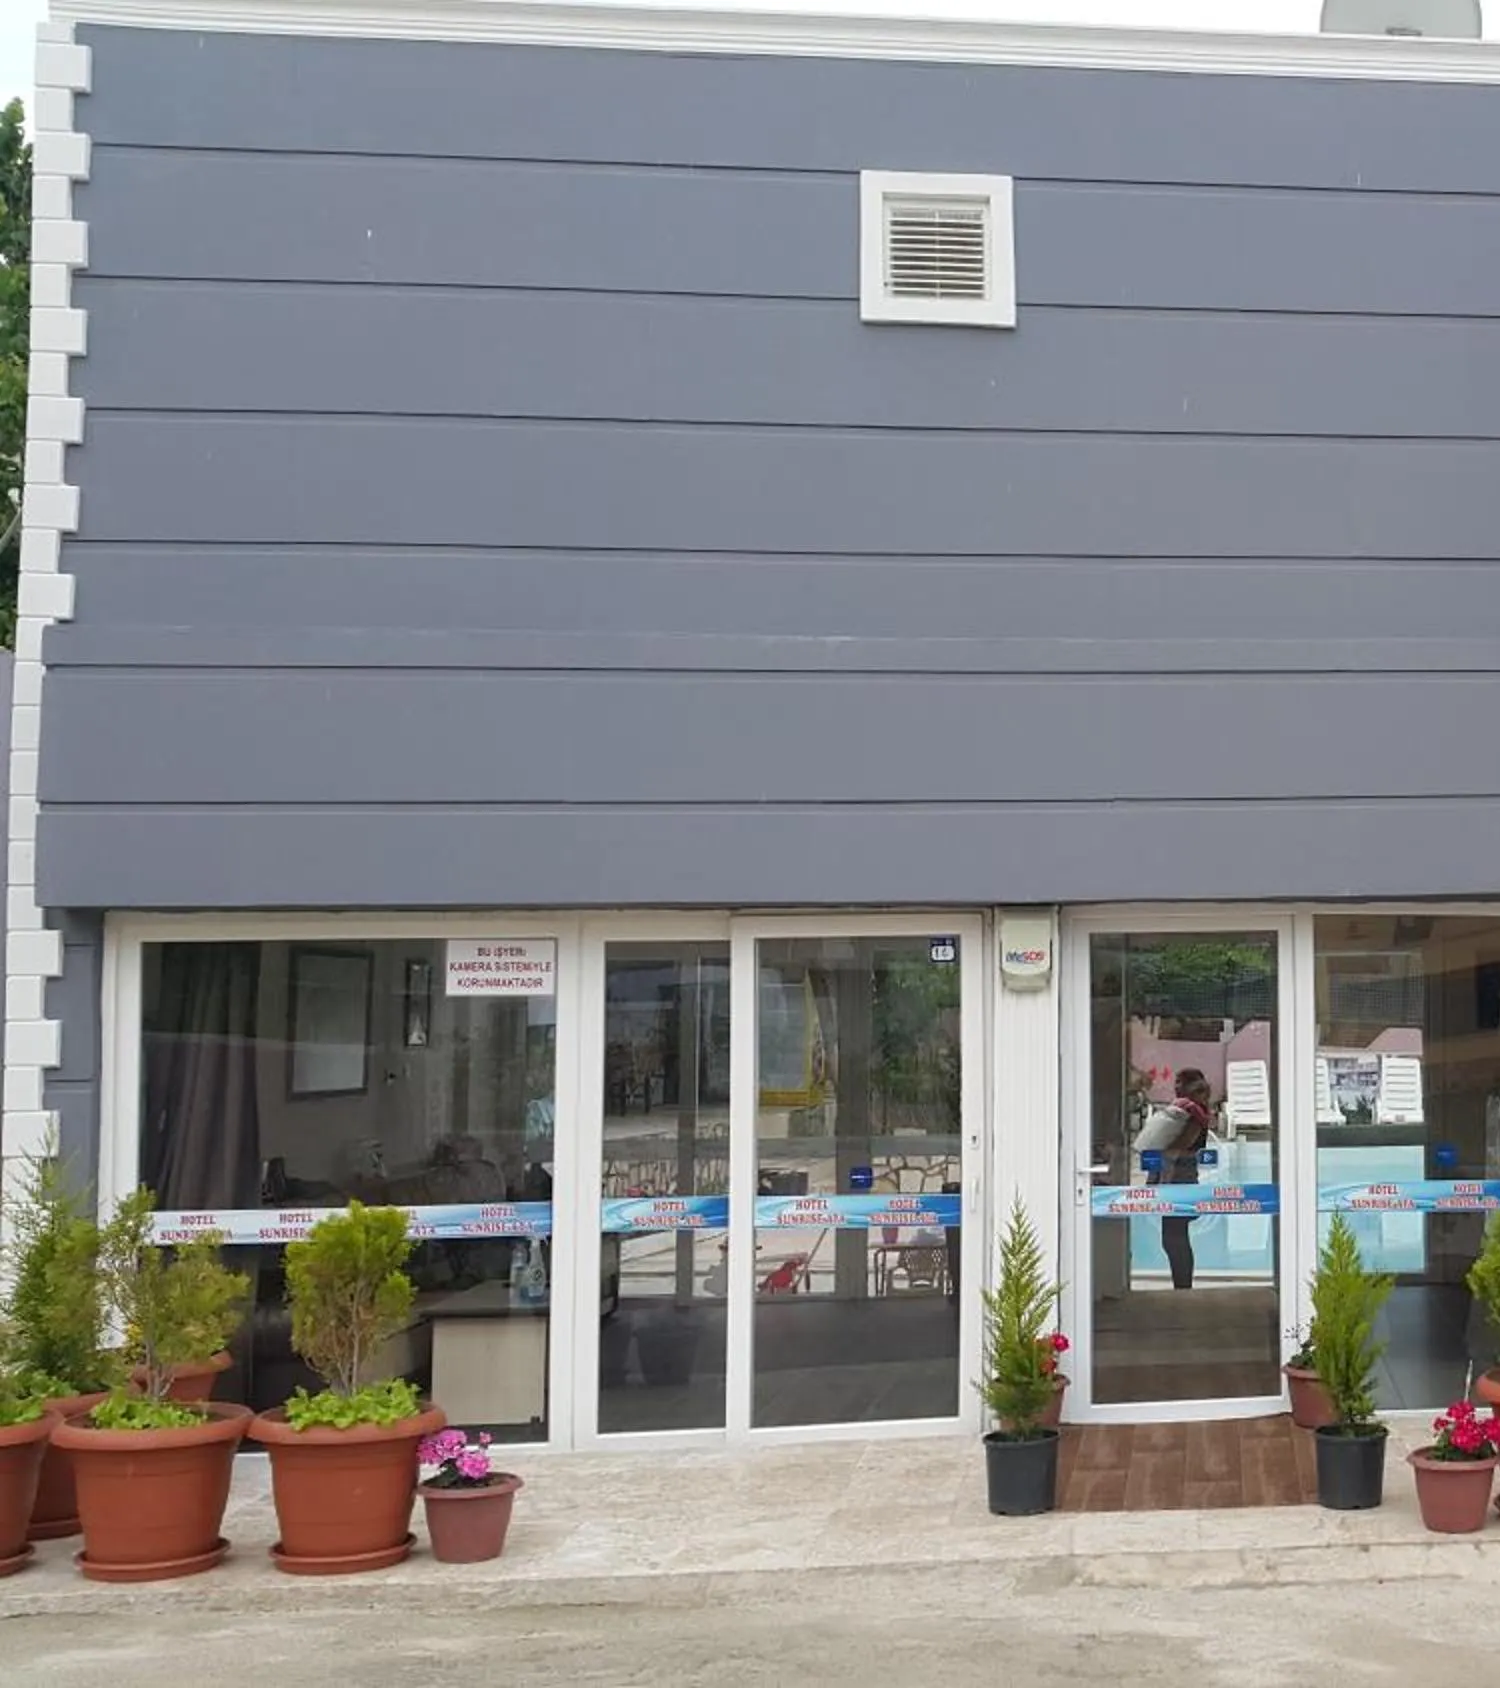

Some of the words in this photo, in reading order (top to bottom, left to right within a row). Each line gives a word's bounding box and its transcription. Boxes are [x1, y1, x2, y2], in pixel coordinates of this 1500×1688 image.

[449, 962, 492, 972] KAMERA
[457, 978, 543, 988] KORUNMAKTADIR
[654, 1201, 687, 1212] HOTEL
[795, 1199, 828, 1210] HOTEL
[279, 1212, 314, 1223] HOTEL
[480, 1207, 516, 1217] HOTEL
[179, 1213, 216, 1225] HOTEL
